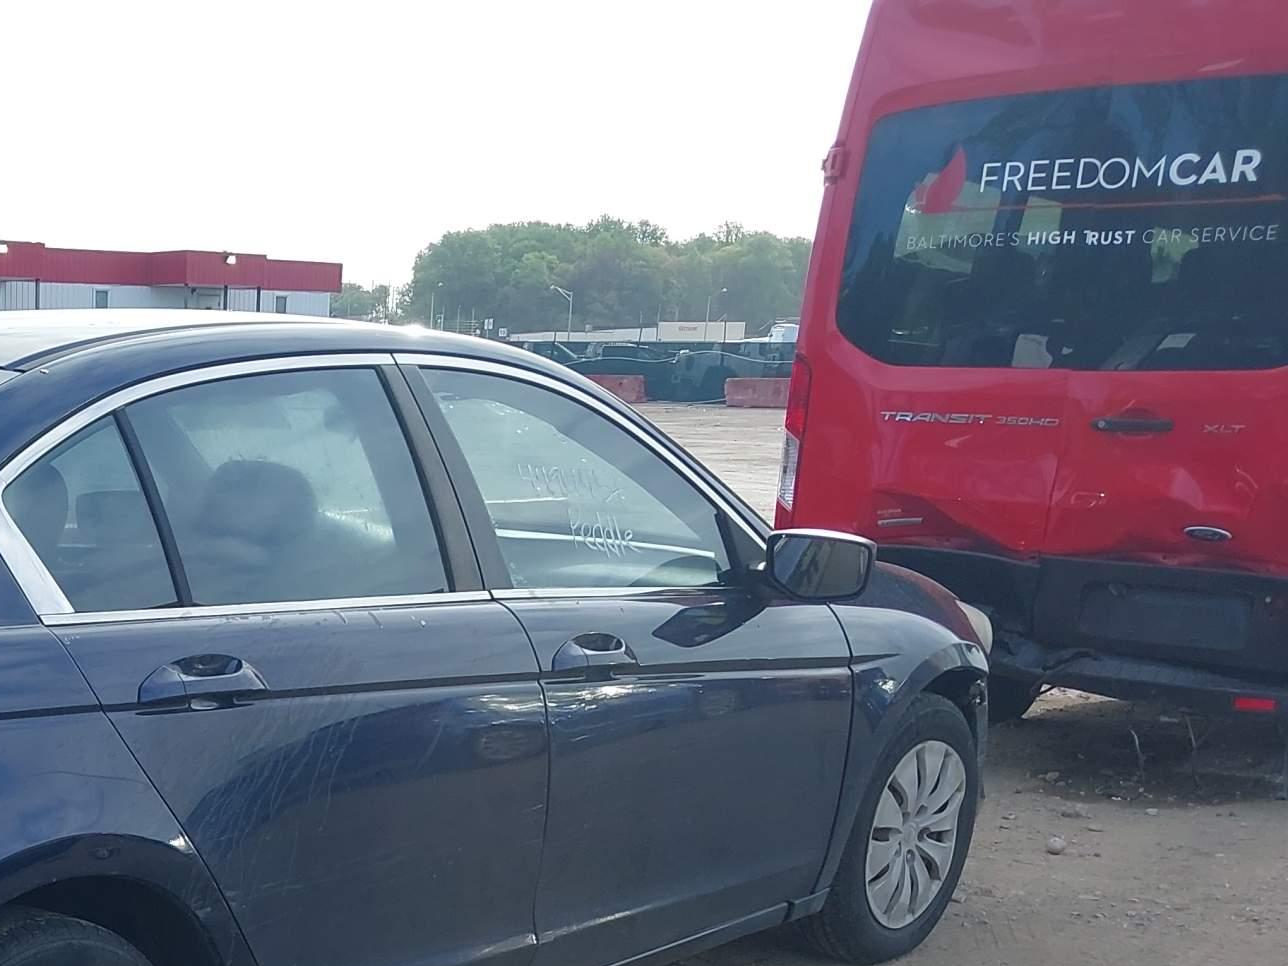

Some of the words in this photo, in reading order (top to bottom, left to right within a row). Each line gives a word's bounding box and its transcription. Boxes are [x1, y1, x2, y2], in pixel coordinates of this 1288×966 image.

[979, 149, 1262, 193] FREEDOMCAR
[906, 231, 1020, 250] BALTIMORE'S
[1026, 230, 1076, 246] HIGH
[1083, 229, 1136, 246] TRUST
[1142, 227, 1182, 244] CAR
[1190, 224, 1280, 243] SERVICE
[880, 410, 993, 425] TRANSIT
[1202, 424, 1247, 433] XLT
